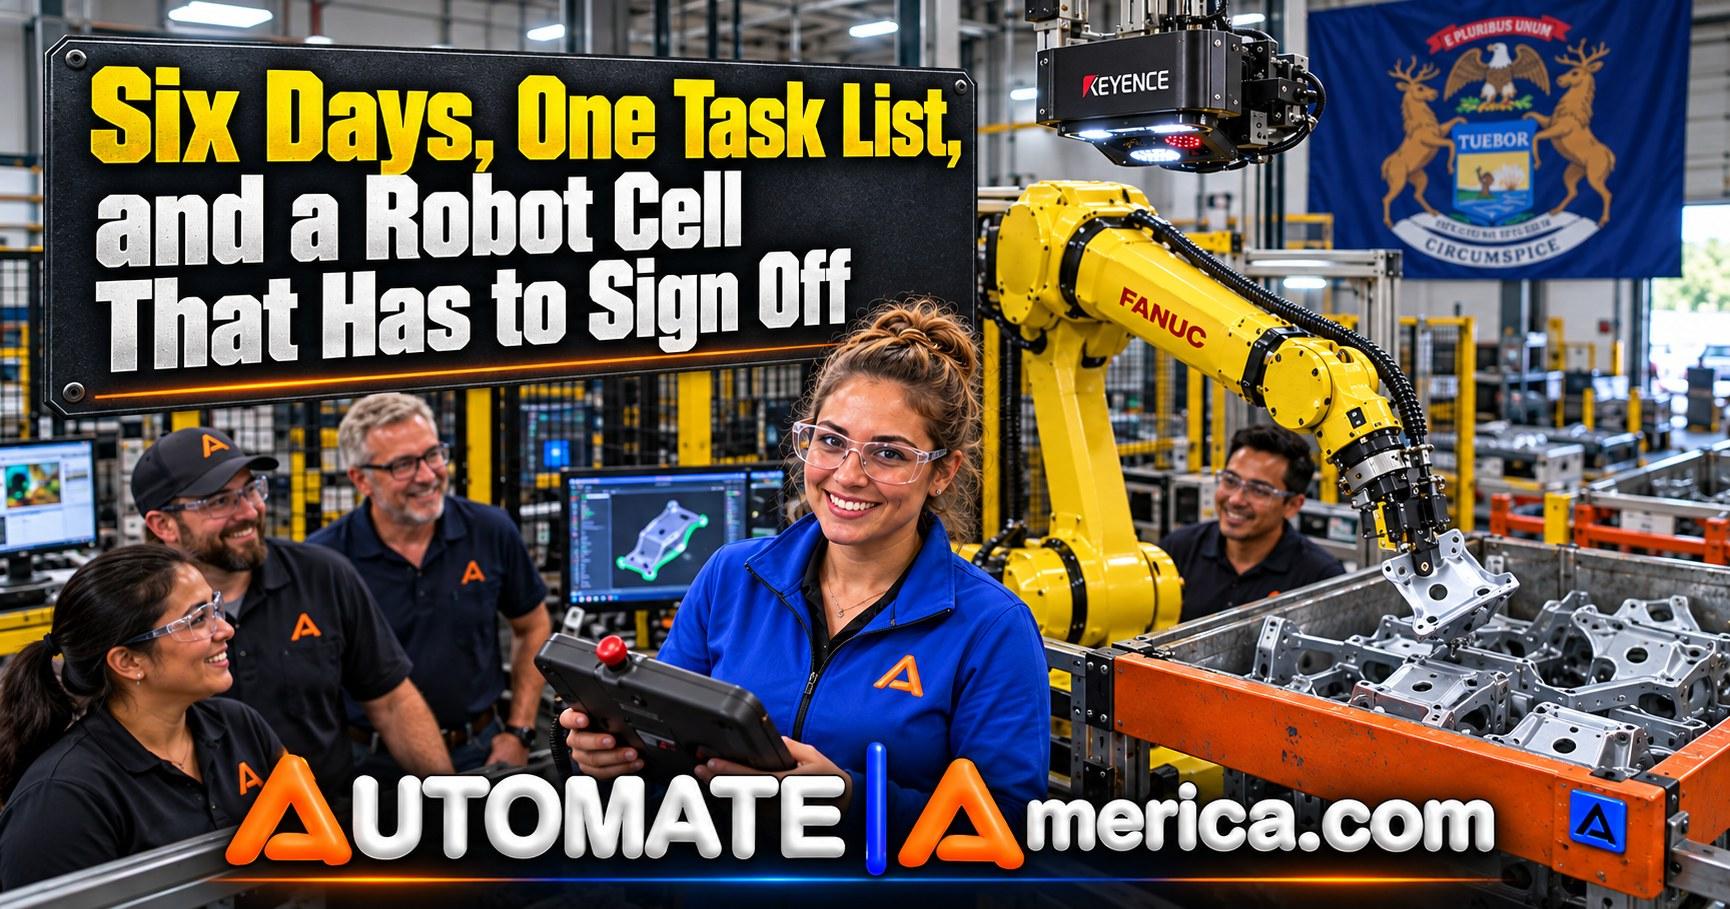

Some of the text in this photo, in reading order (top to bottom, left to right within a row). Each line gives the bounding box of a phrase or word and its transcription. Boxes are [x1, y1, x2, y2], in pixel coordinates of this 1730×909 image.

[1443, 19, 1553, 47] E PLURIBUS UNUM
[1082, 70, 1169, 97] KEYENCE
[91, 66, 962, 175] Six Days, One Task List,
[1458, 131, 1529, 149] TUEBOR
[96, 170, 742, 268] and a Robot Cell
[1425, 237, 1561, 264] CIRCUMSPICE
[95, 248, 852, 373] That Has to Sign Off
[1119, 286, 1207, 349] FANUC
